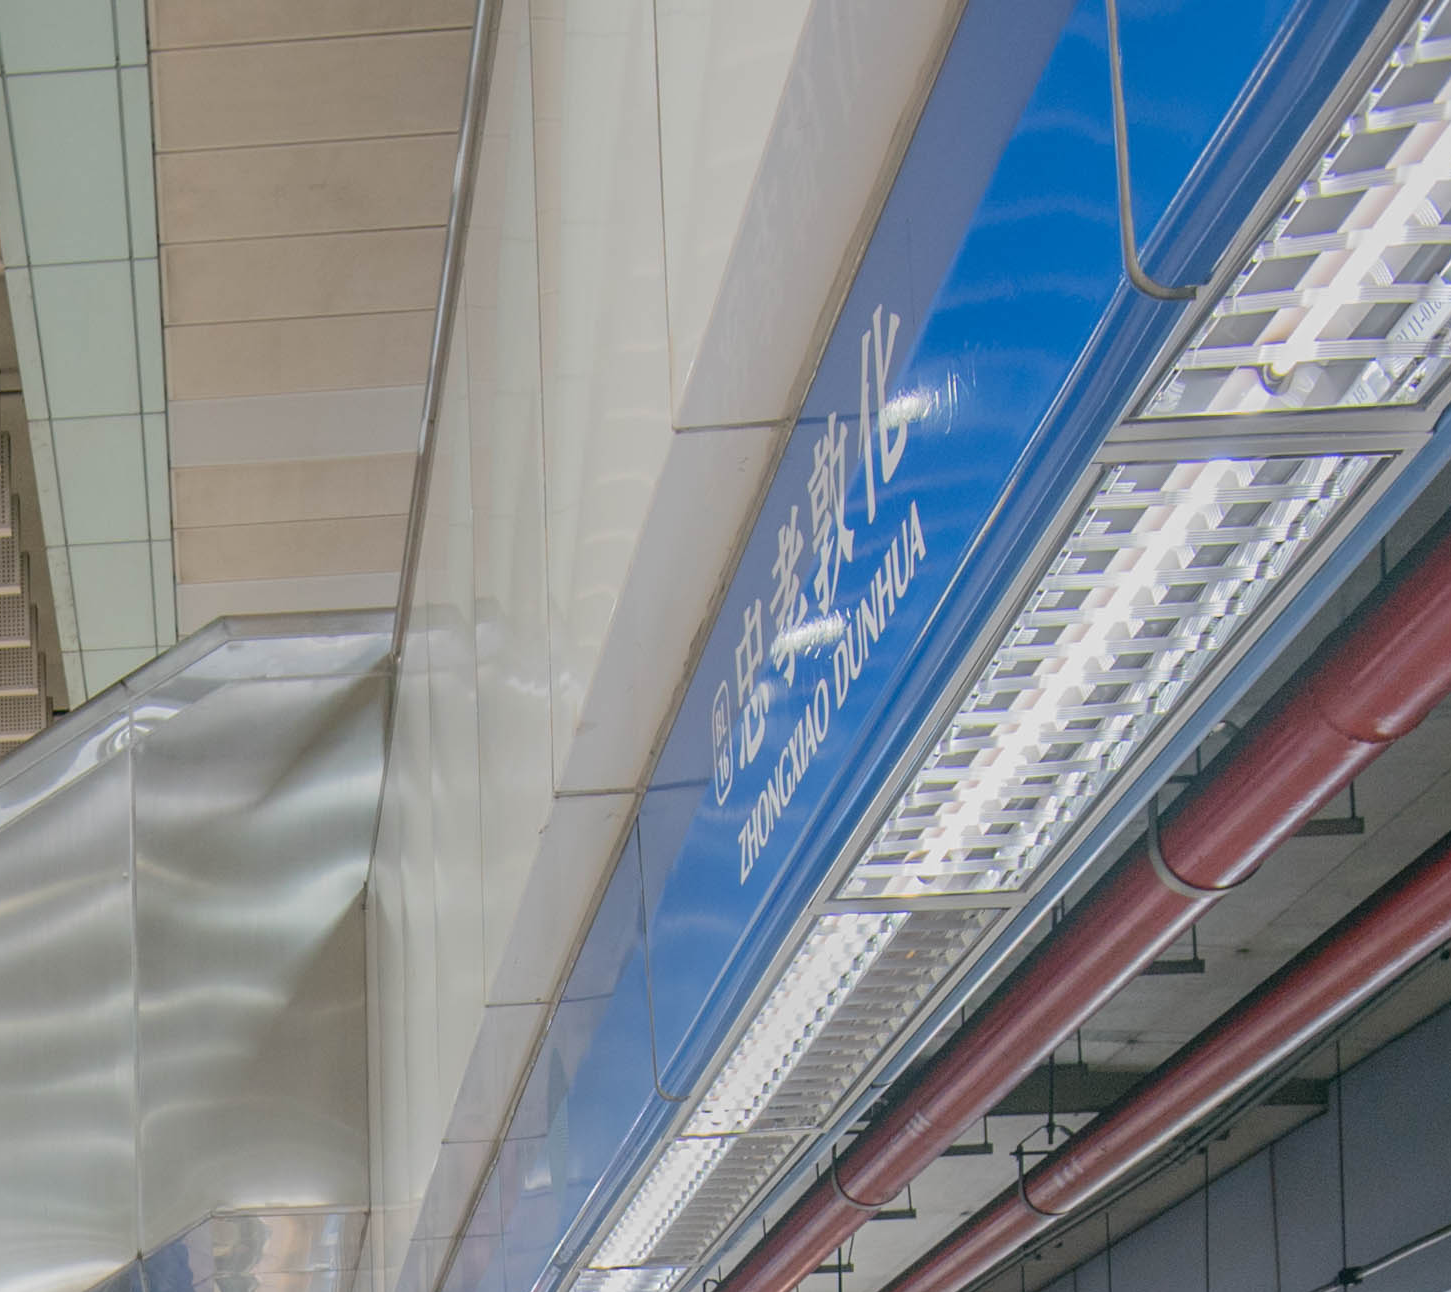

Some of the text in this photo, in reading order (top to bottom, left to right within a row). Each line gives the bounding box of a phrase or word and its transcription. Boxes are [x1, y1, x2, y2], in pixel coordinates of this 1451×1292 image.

[734, 303, 912, 770] 忠孝敦化
[714, 707, 730, 743] BL
[716, 744, 732, 785] 16
[738, 500, 927, 885] ZHONGXIAO DUNHUA
